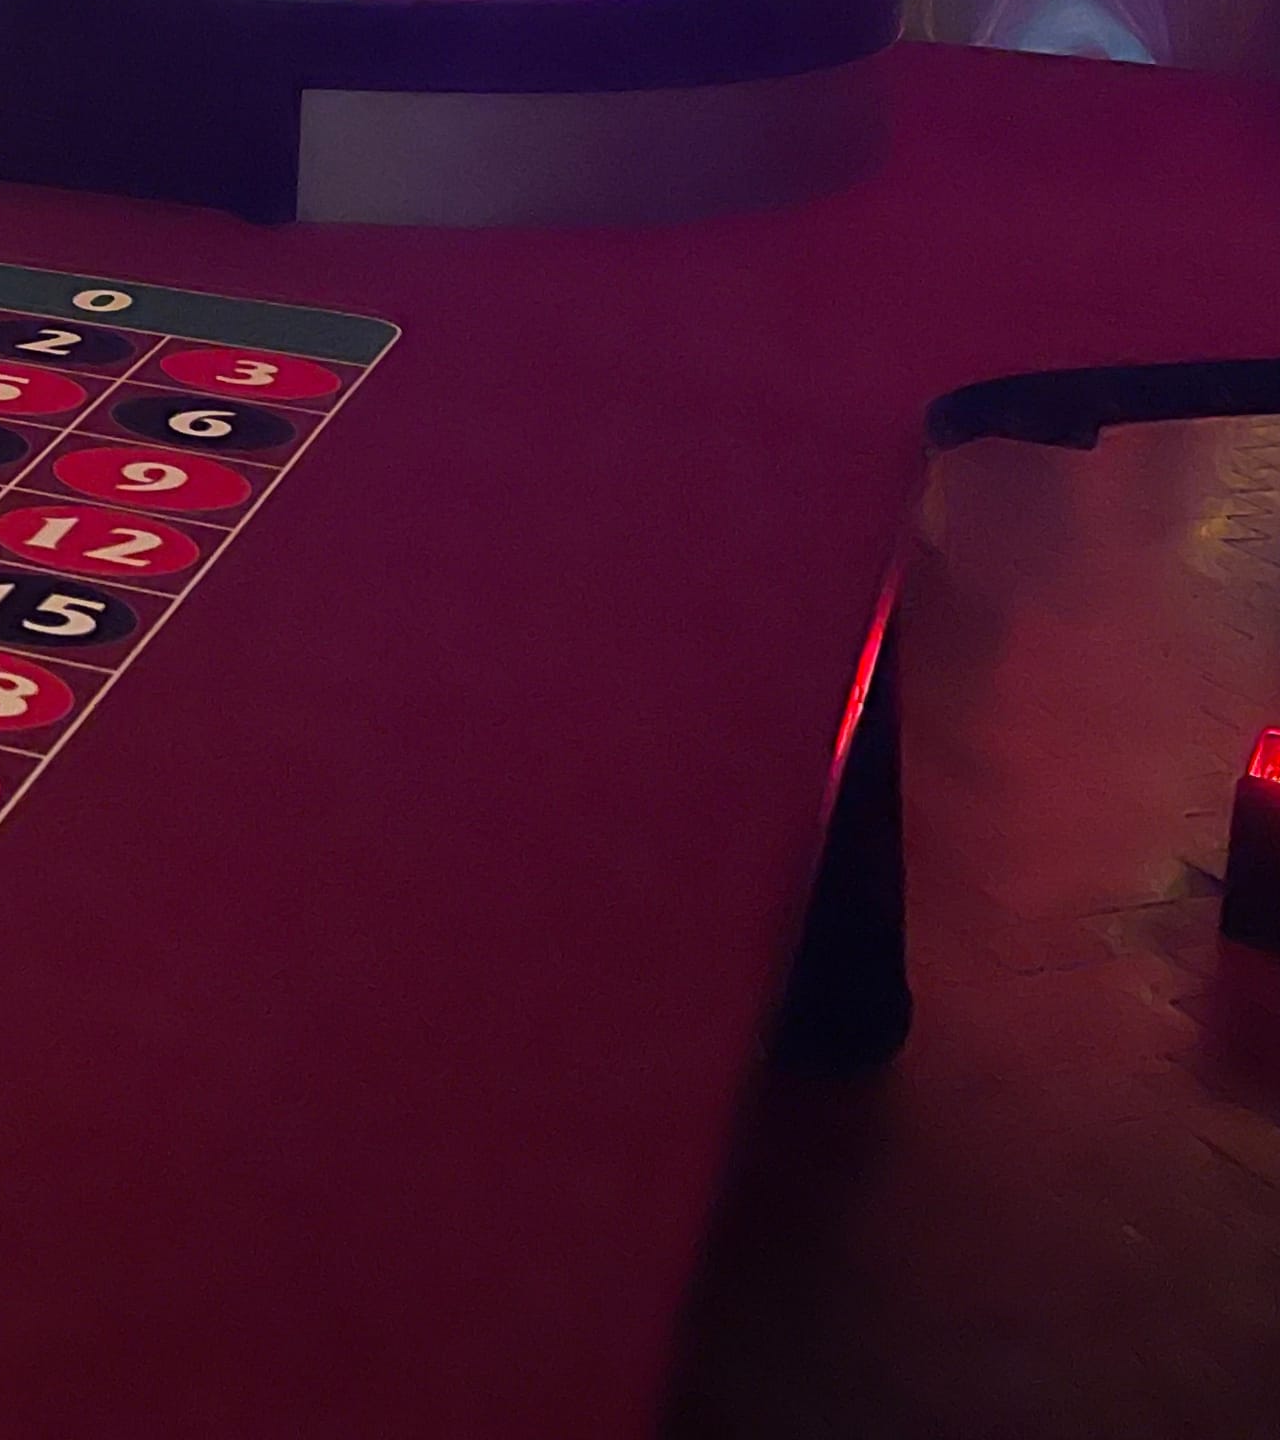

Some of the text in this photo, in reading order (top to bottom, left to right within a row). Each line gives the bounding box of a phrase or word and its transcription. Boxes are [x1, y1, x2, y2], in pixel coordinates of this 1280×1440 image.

[71, 288, 134, 313] 0
[15, 328, 83, 356] 2
[215, 359, 279, 386] 3
[167, 409, 236, 438] 6
[116, 461, 189, 492] 9
[24, 516, 163, 568] 12
